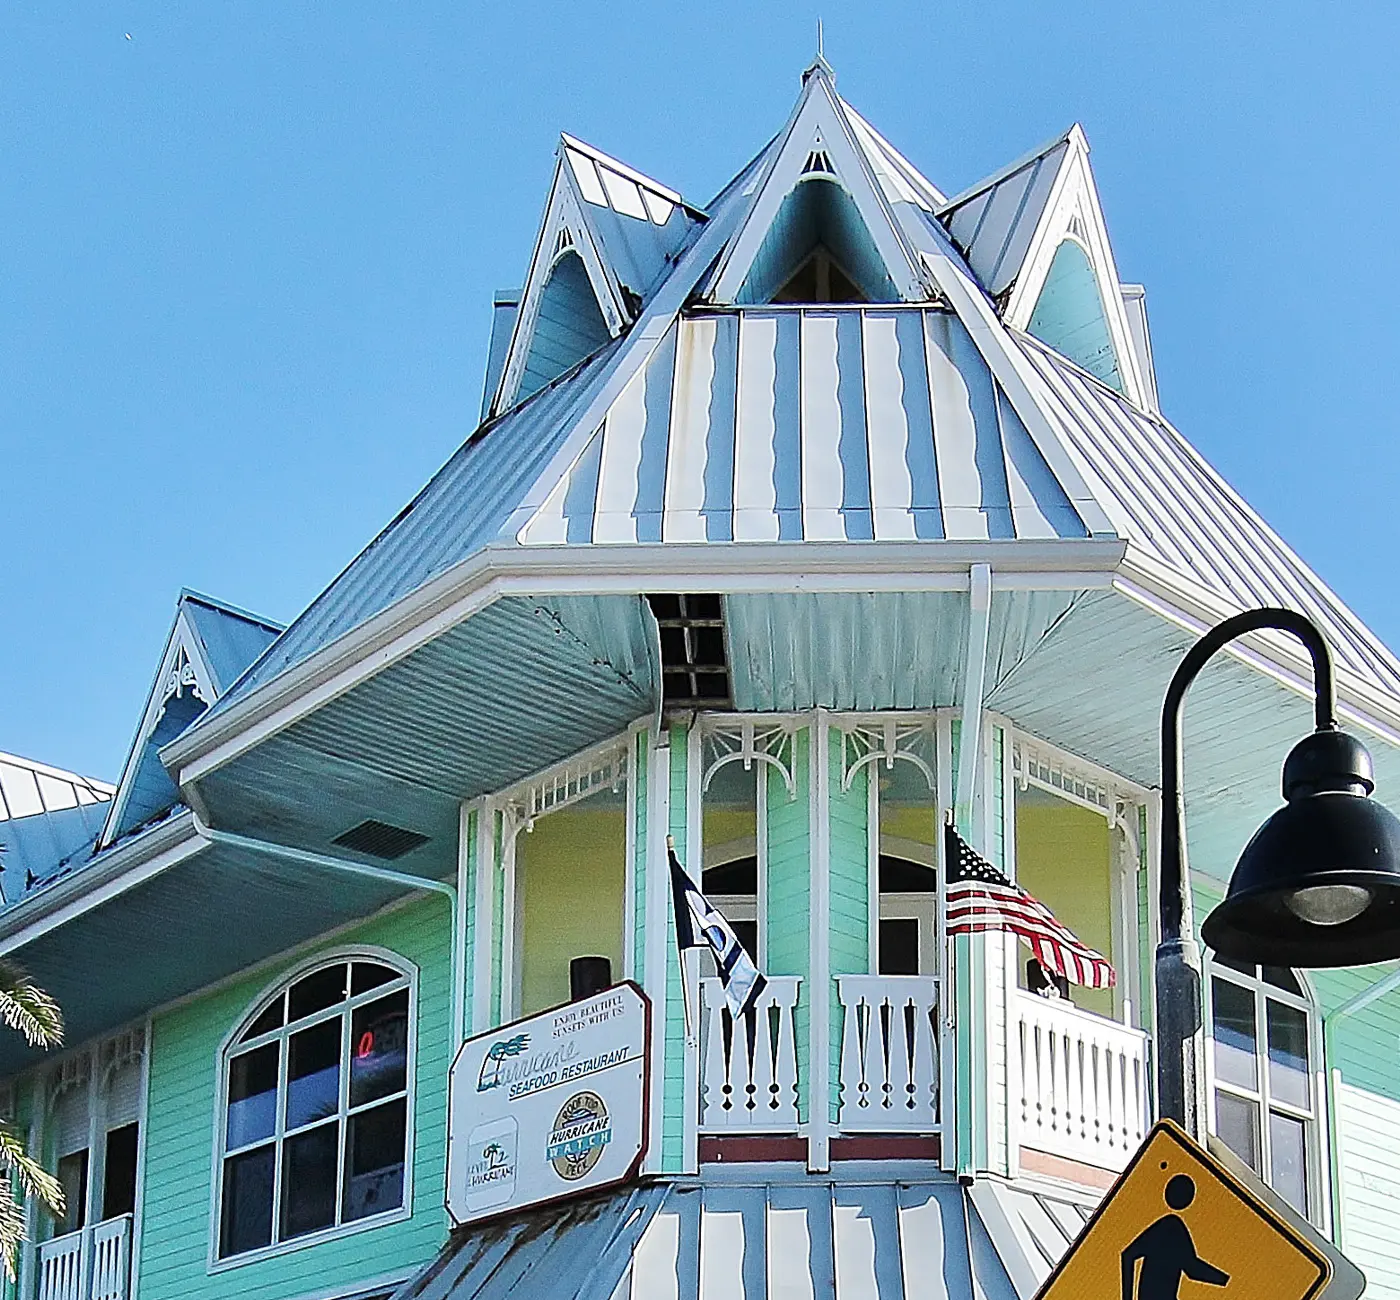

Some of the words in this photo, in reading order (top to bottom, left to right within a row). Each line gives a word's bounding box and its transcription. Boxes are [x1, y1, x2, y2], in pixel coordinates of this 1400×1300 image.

[552, 1022, 586, 1039] SUNSETS
[588, 1013, 609, 1028] WITH
[553, 1012, 577, 1028] ENJOY
[580, 996, 623, 1019] BEAUTIFUL
[508, 1071, 558, 1098] SEAFOOD
[560, 1046, 631, 1080] RESTAURANT
[549, 1131, 609, 1158] WATCH
[550, 1116, 610, 1145] HURRICANE
[565, 1160, 590, 1176] DECK
